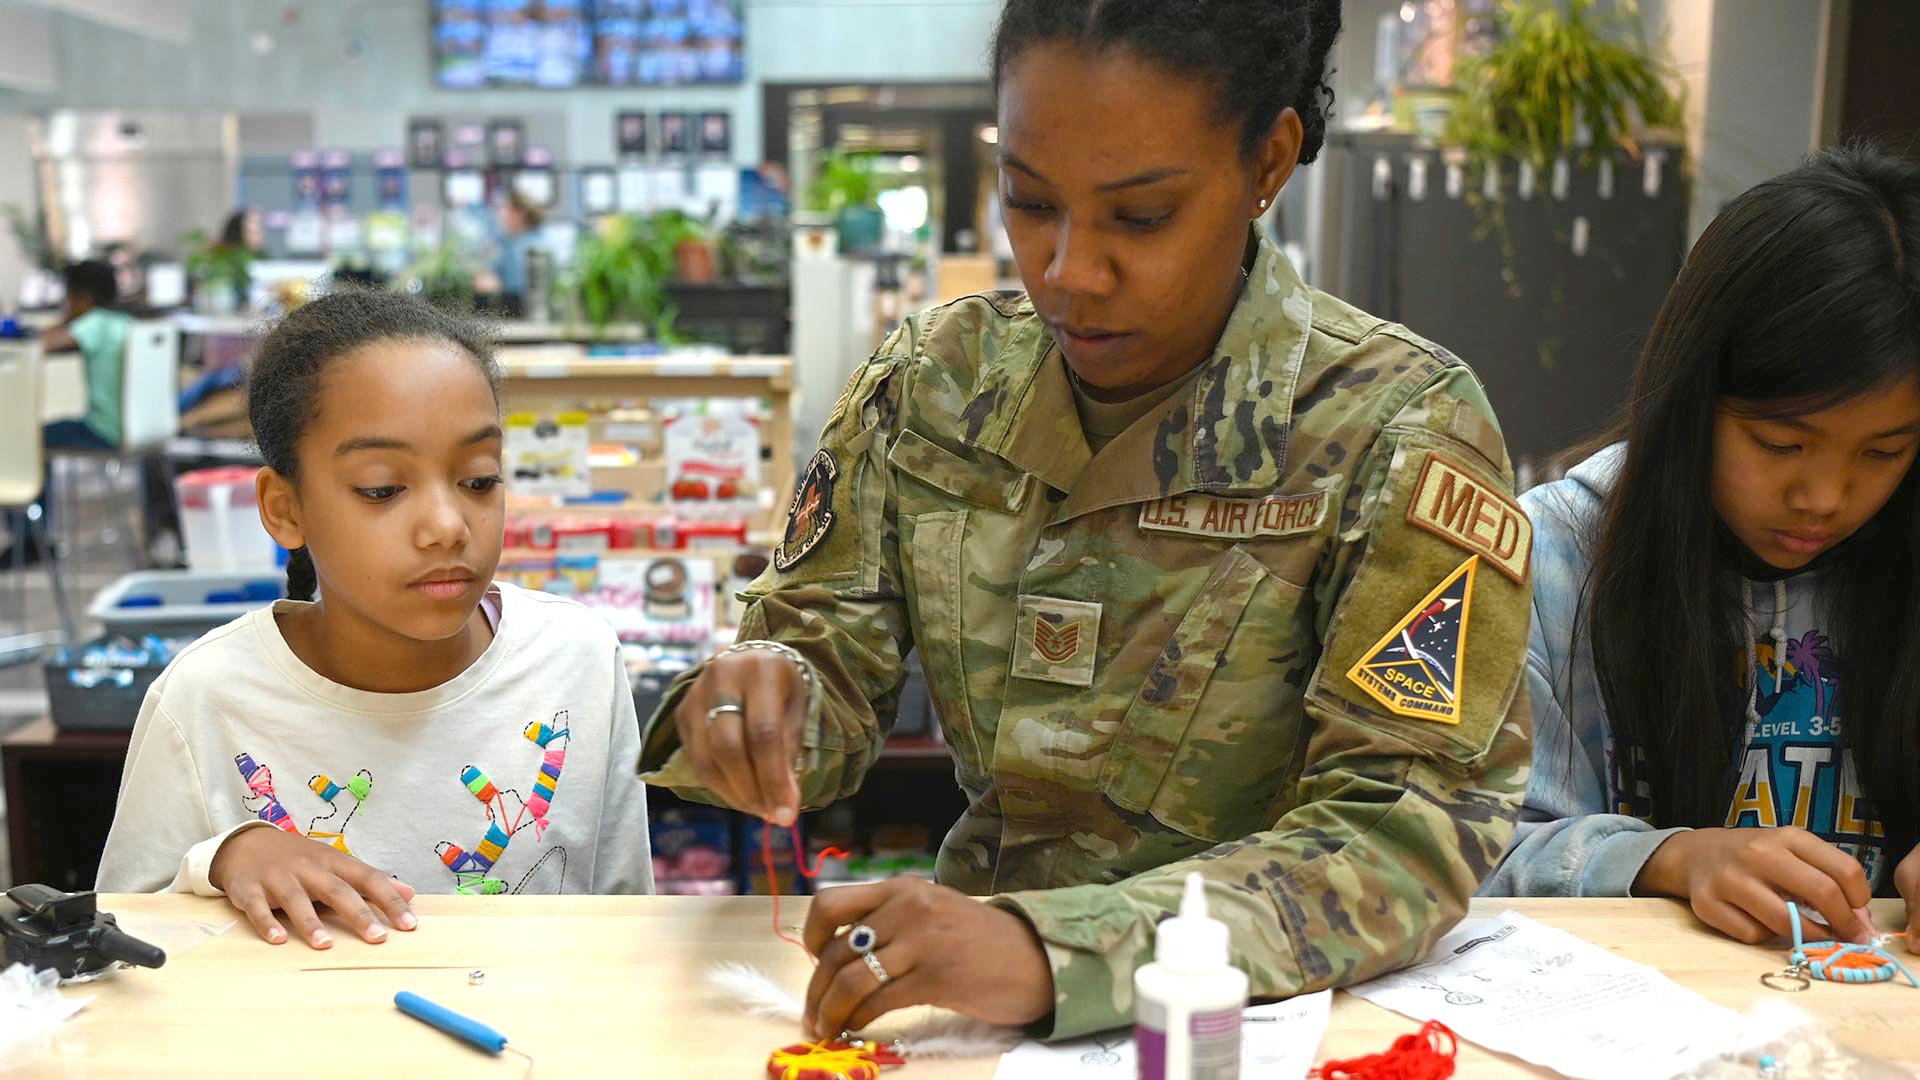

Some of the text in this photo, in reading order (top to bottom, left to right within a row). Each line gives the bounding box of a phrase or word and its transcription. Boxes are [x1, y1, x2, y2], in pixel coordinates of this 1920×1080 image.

[1144, 494, 1324, 533] U.S. AIR FORCE
[1429, 470, 1519, 560] MED
[1358, 668, 1453, 715] SYSTEMS COMMAND
[1384, 668, 1435, 698] SPACE
